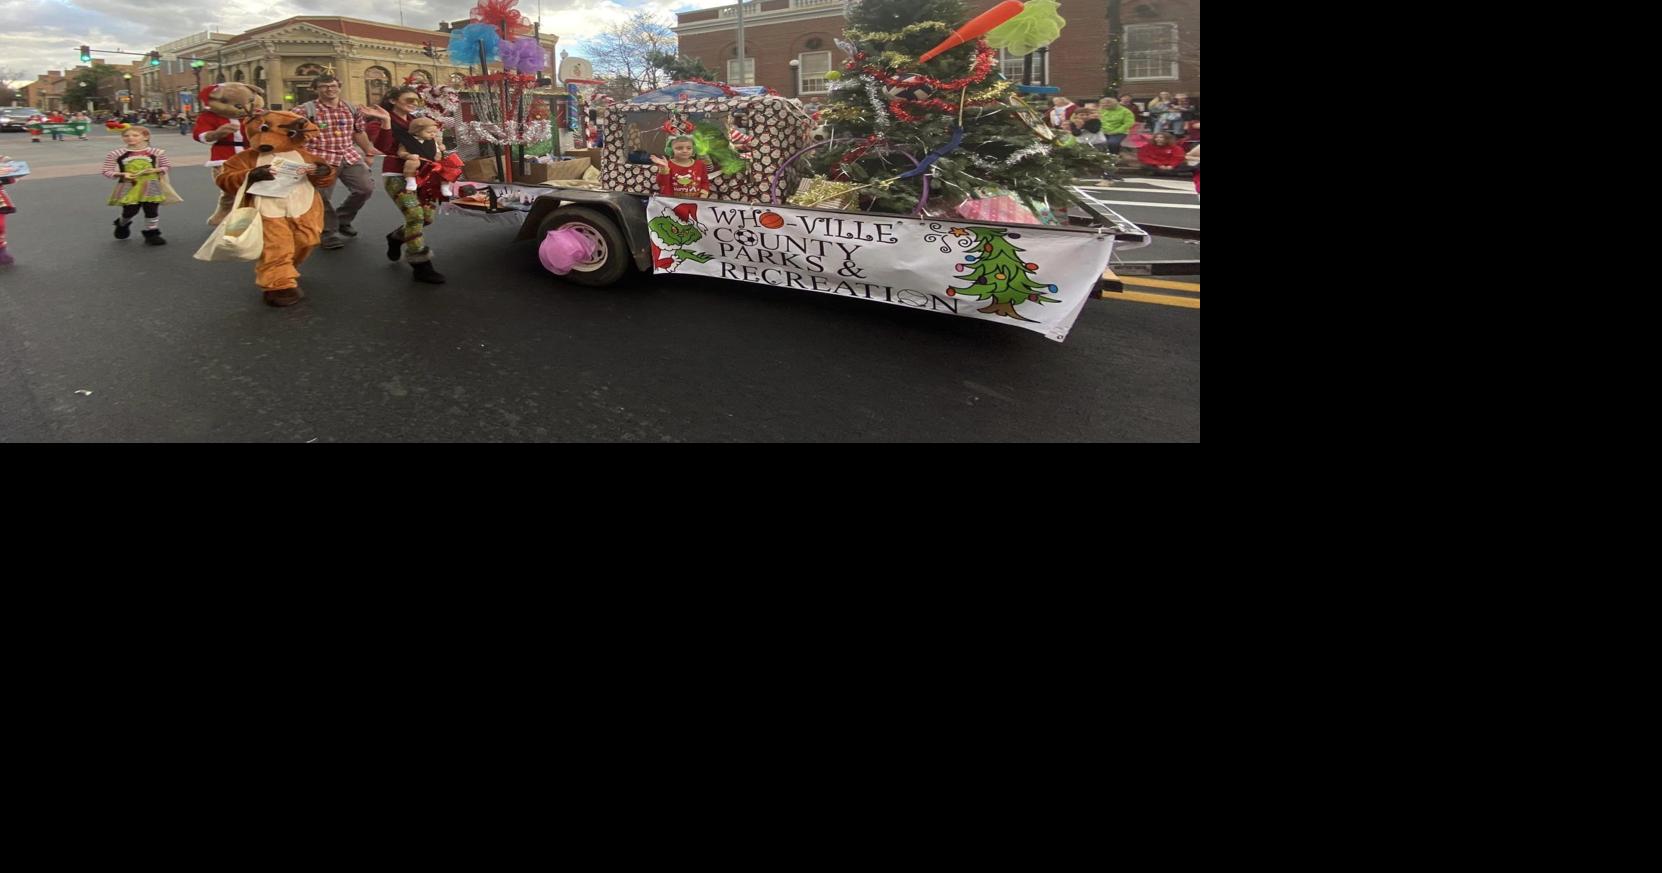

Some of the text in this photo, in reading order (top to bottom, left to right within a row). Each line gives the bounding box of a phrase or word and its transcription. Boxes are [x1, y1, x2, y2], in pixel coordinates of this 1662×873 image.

[713, 227, 861, 261] COUNTY
[719, 242, 867, 279] PARKS &
[721, 261, 959, 314] RECREATION
